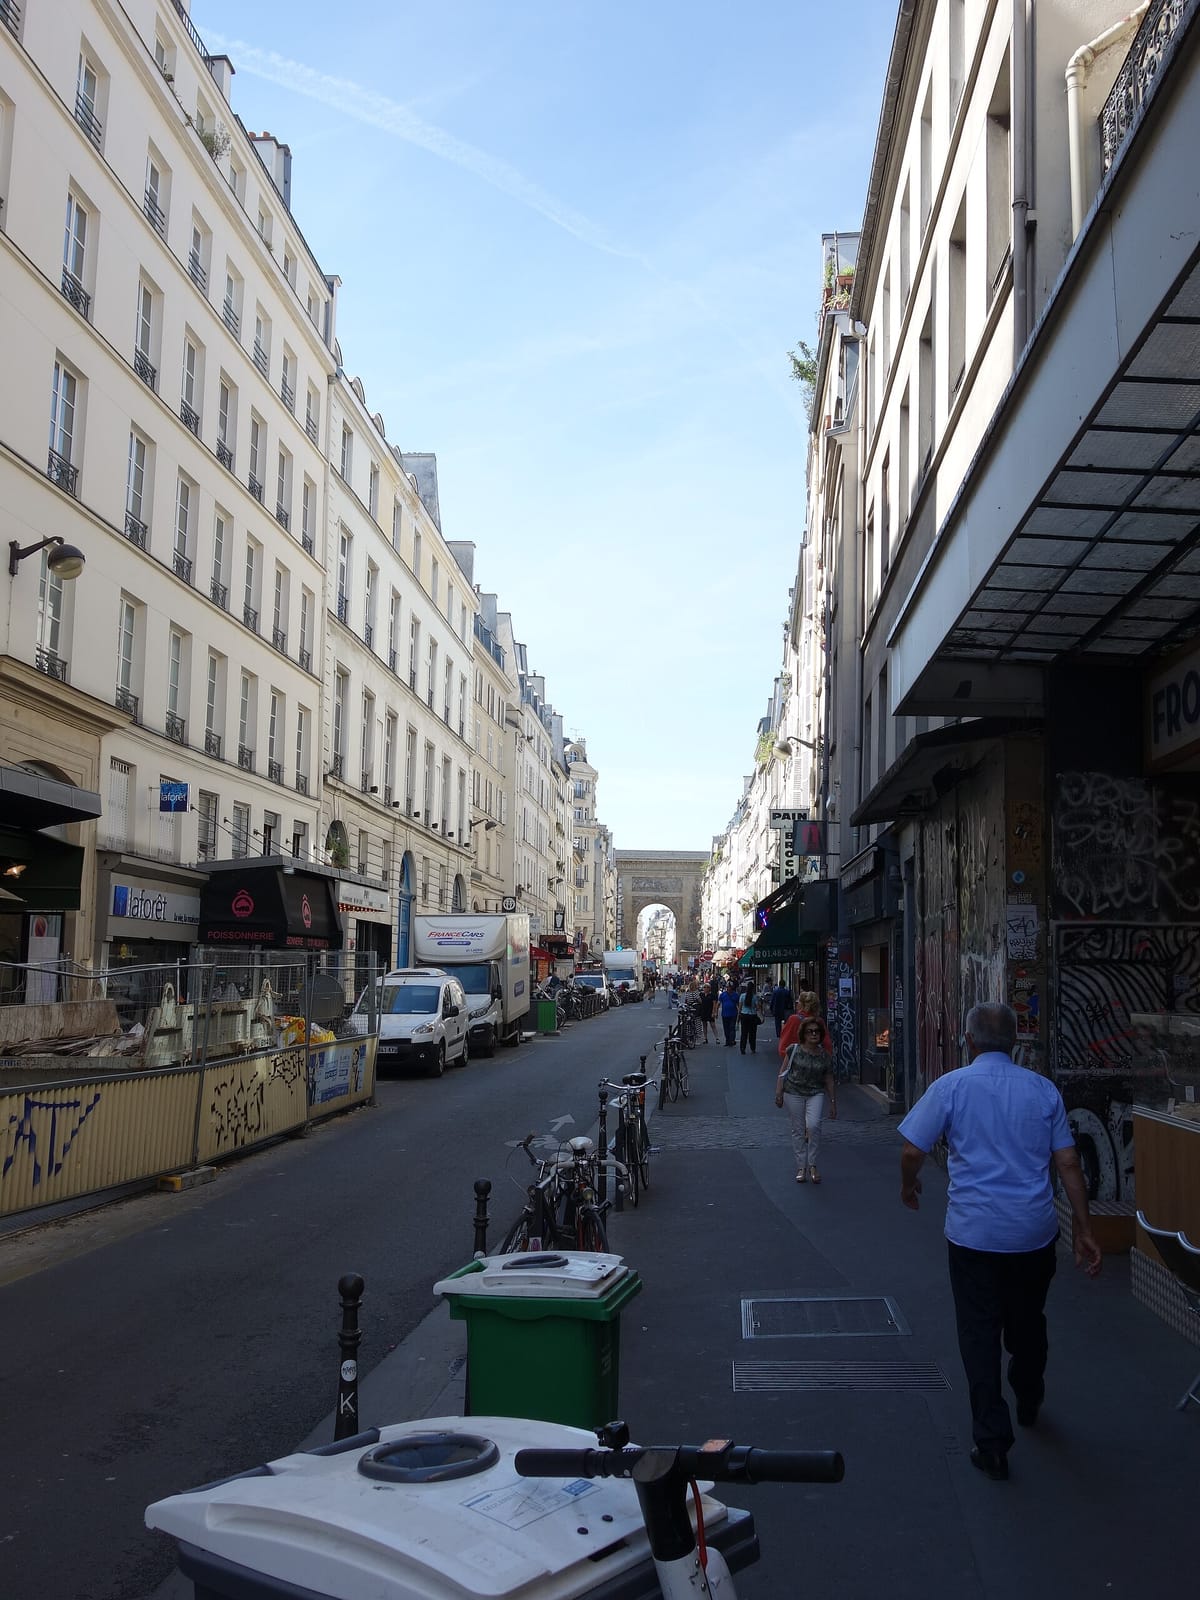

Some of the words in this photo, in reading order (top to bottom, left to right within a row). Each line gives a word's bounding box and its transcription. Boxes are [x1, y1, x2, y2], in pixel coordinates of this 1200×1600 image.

[1153, 670, 1200, 744] FRO
[772, 812, 808, 820] PAIN
[129, 888, 168, 920] laforêt
[207, 930, 274, 941] POISSONNERIE
[340, 1391, 355, 1415] K
